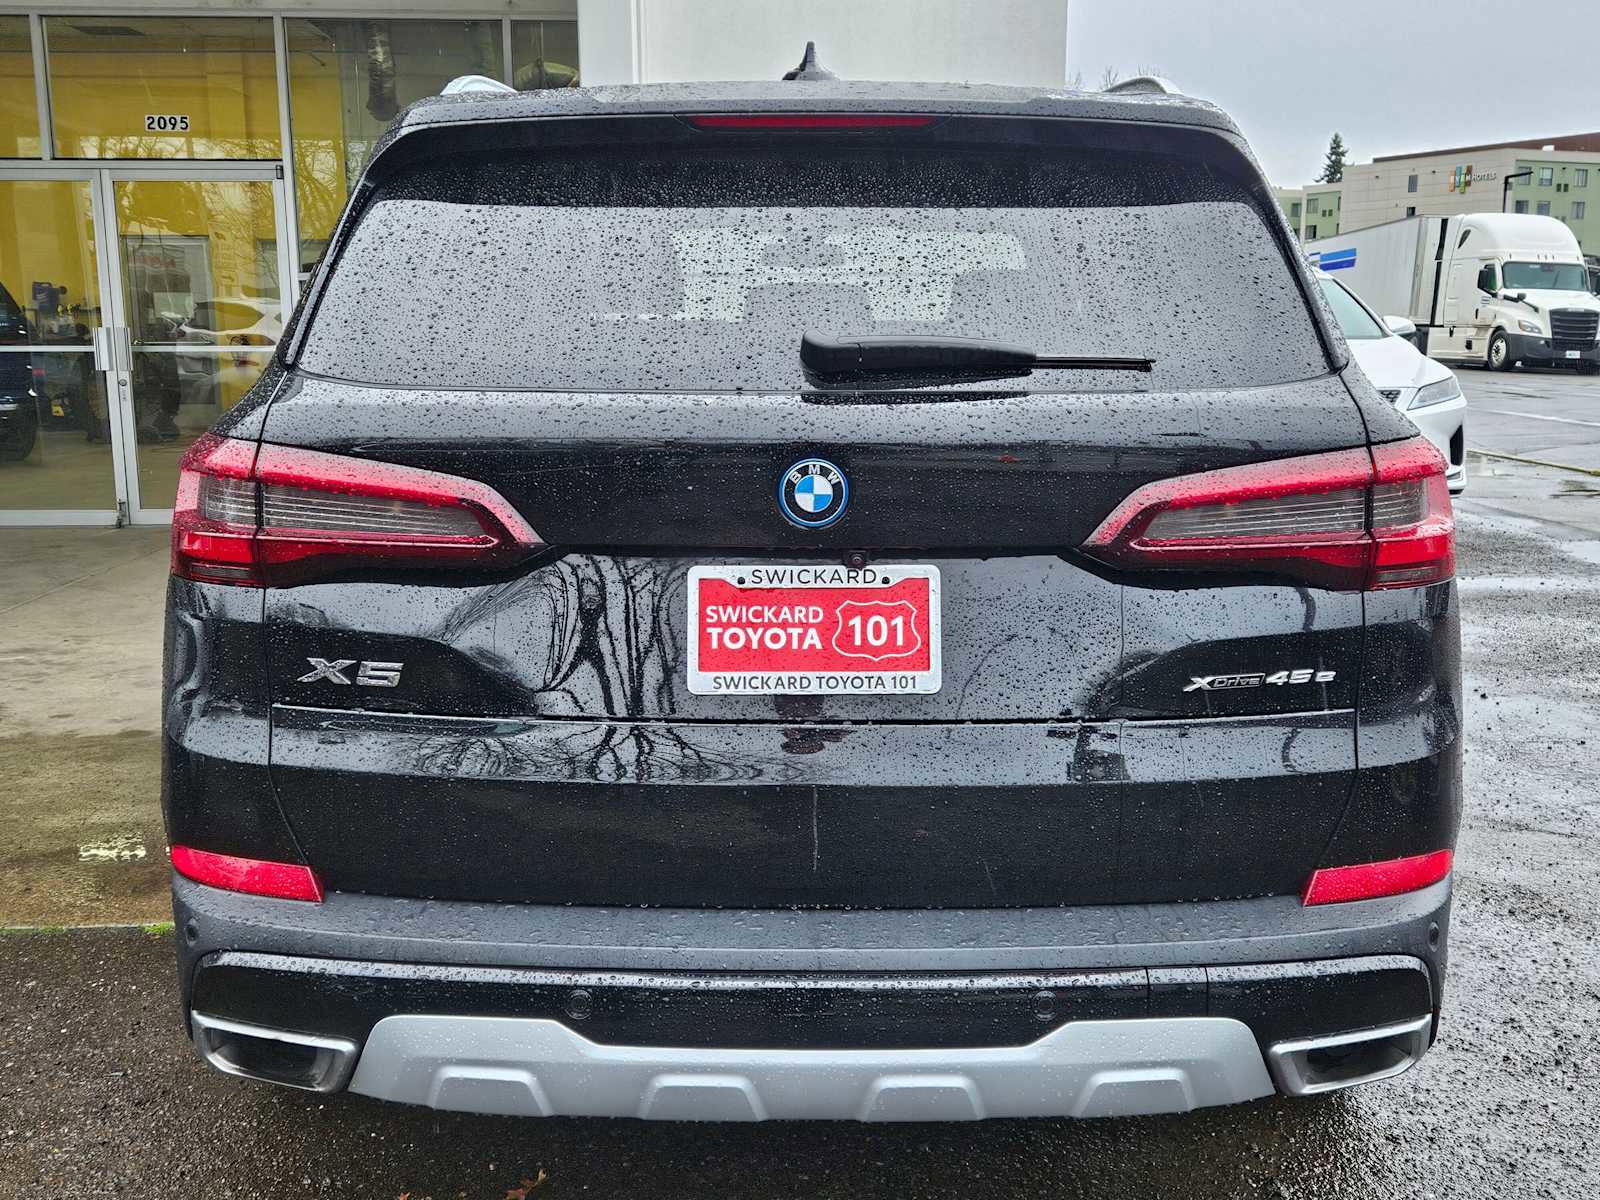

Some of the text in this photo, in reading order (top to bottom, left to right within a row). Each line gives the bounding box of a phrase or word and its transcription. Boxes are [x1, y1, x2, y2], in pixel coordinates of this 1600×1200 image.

[146, 116, 189, 131] 2095
[789, 464, 841, 485] BMW
[751, 569, 877, 585] SWICKARD
[705, 605, 824, 624] SWICKARD
[706, 627, 823, 650] TOYOTA
[847, 615, 905, 647] 101
[296, 657, 405, 688] X5
[712, 675, 917, 690] SWICKARD TOYOTA 101
